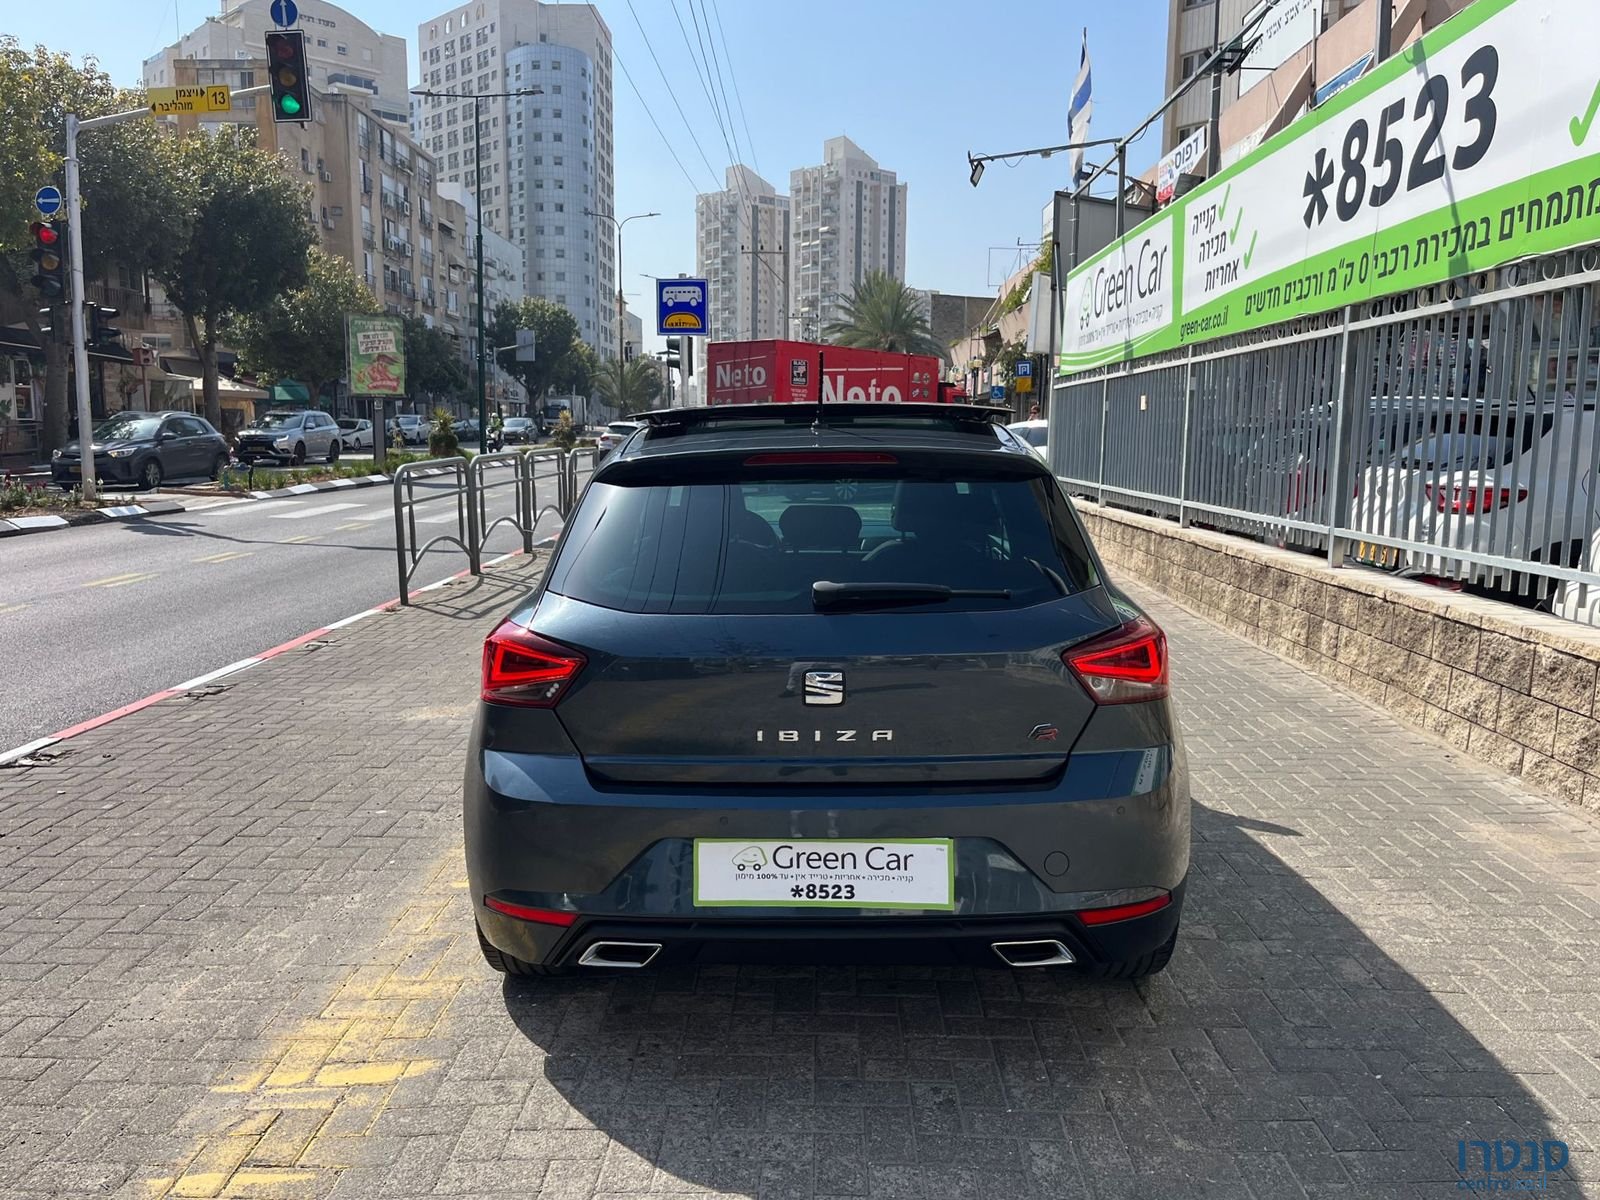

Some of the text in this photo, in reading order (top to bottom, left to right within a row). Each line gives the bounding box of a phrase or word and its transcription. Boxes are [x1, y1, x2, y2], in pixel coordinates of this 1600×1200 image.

[158, 100, 193, 111] מוהליבר
[176, 88, 198, 100] ויצמן
[212, 91, 226, 105] 13
[1175, 137, 1199, 169] דפוס
[1192, 204, 1217, 235] קנייה
[1199, 231, 1227, 263] מכירה
[1413, 216, 1491, 268] במכירת
[1205, 258, 1240, 292] אחריות
[1358, 252, 1369, 285] 0
[1373, 244, 1409, 279] רכבי
[1094, 239, 1168, 318] Green Car
[1284, 271, 1324, 305] ורכבים
[1245, 286, 1280, 316] חדשים
[1180, 305, 1229, 341] green-car.co.il
[716, 363, 766, 388] Neto
[757, 730, 893, 741] IBIZA
[772, 845, 914, 871] Green Car
[735, 873, 754, 881] מימון
[795, 873, 806, 881] אין
[834, 873, 861, 881] אחריות
[896, 875, 914, 883] קניה
